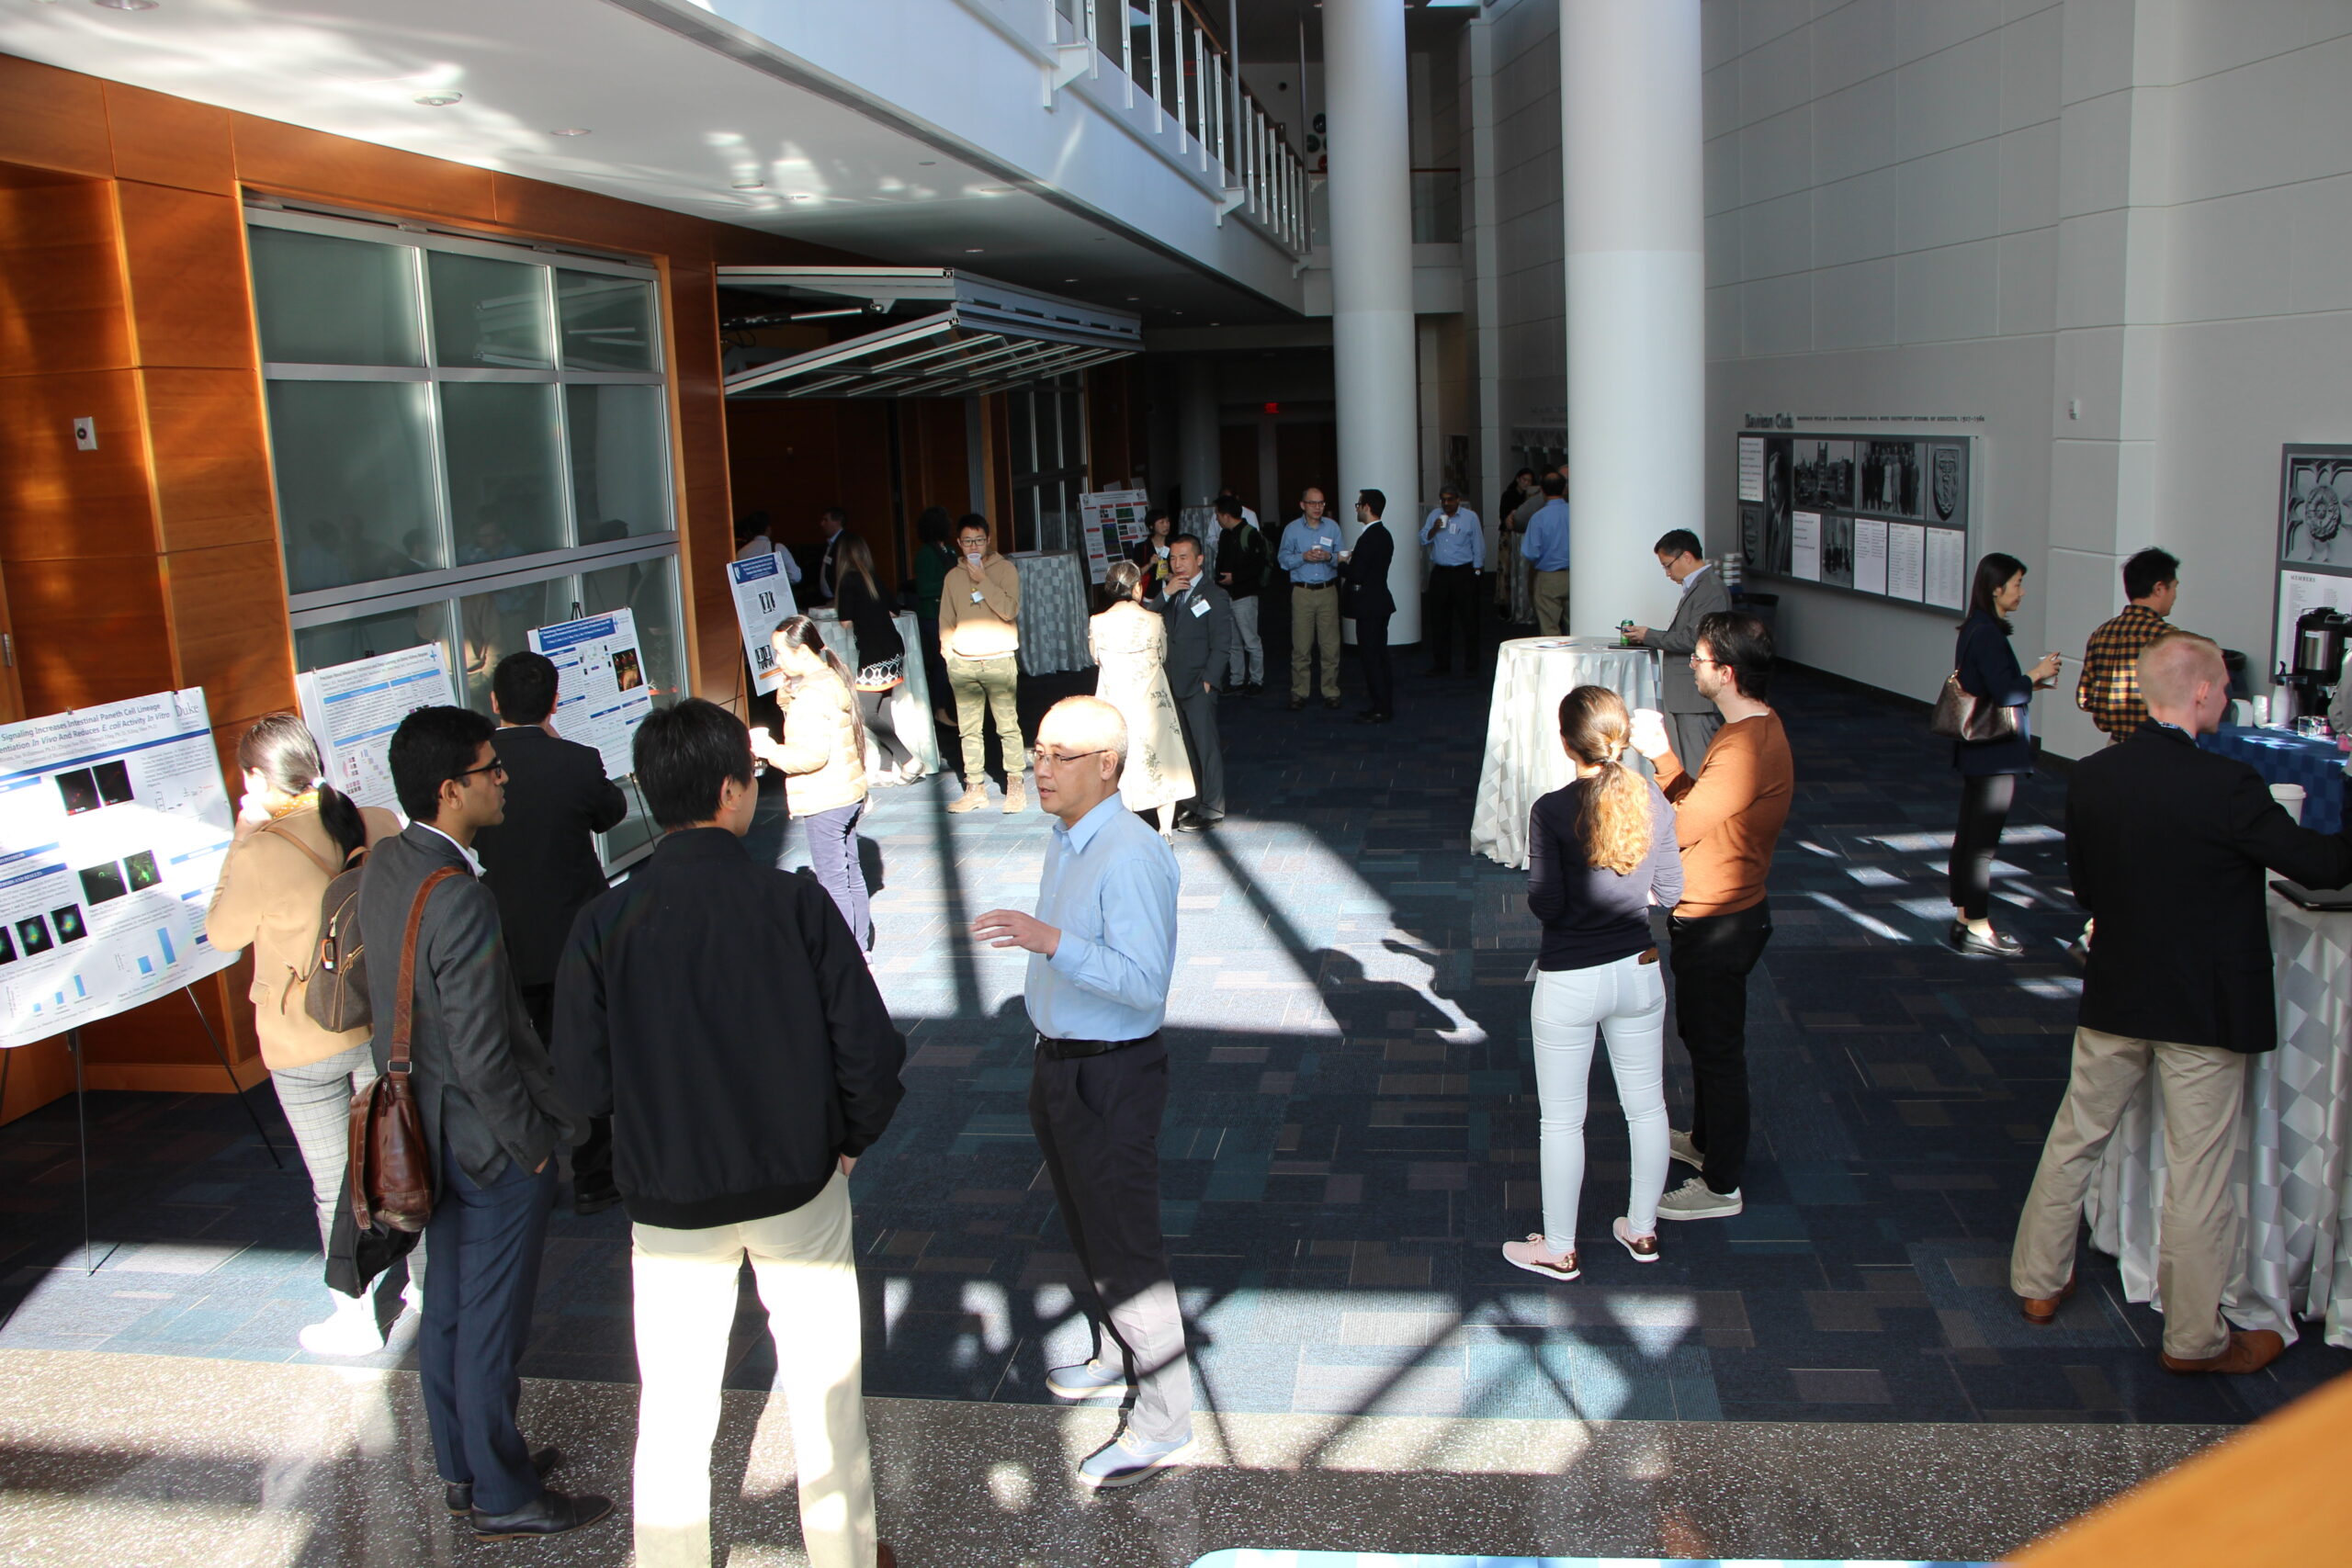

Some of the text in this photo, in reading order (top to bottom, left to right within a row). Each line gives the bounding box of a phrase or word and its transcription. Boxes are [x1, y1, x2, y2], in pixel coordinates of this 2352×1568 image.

[2, 703, 161, 742] Signaling Increases Intestinal Paneth Cell Lineage
[175, 703, 199, 717] Duke
[41, 735, 58, 745] Vivo
[59, 732, 73, 741] And
[74, 727, 100, 739] Reduces
[109, 721, 122, 730] coli
[122, 716, 146, 728] Activity
[155, 711, 171, 720] Vitro
